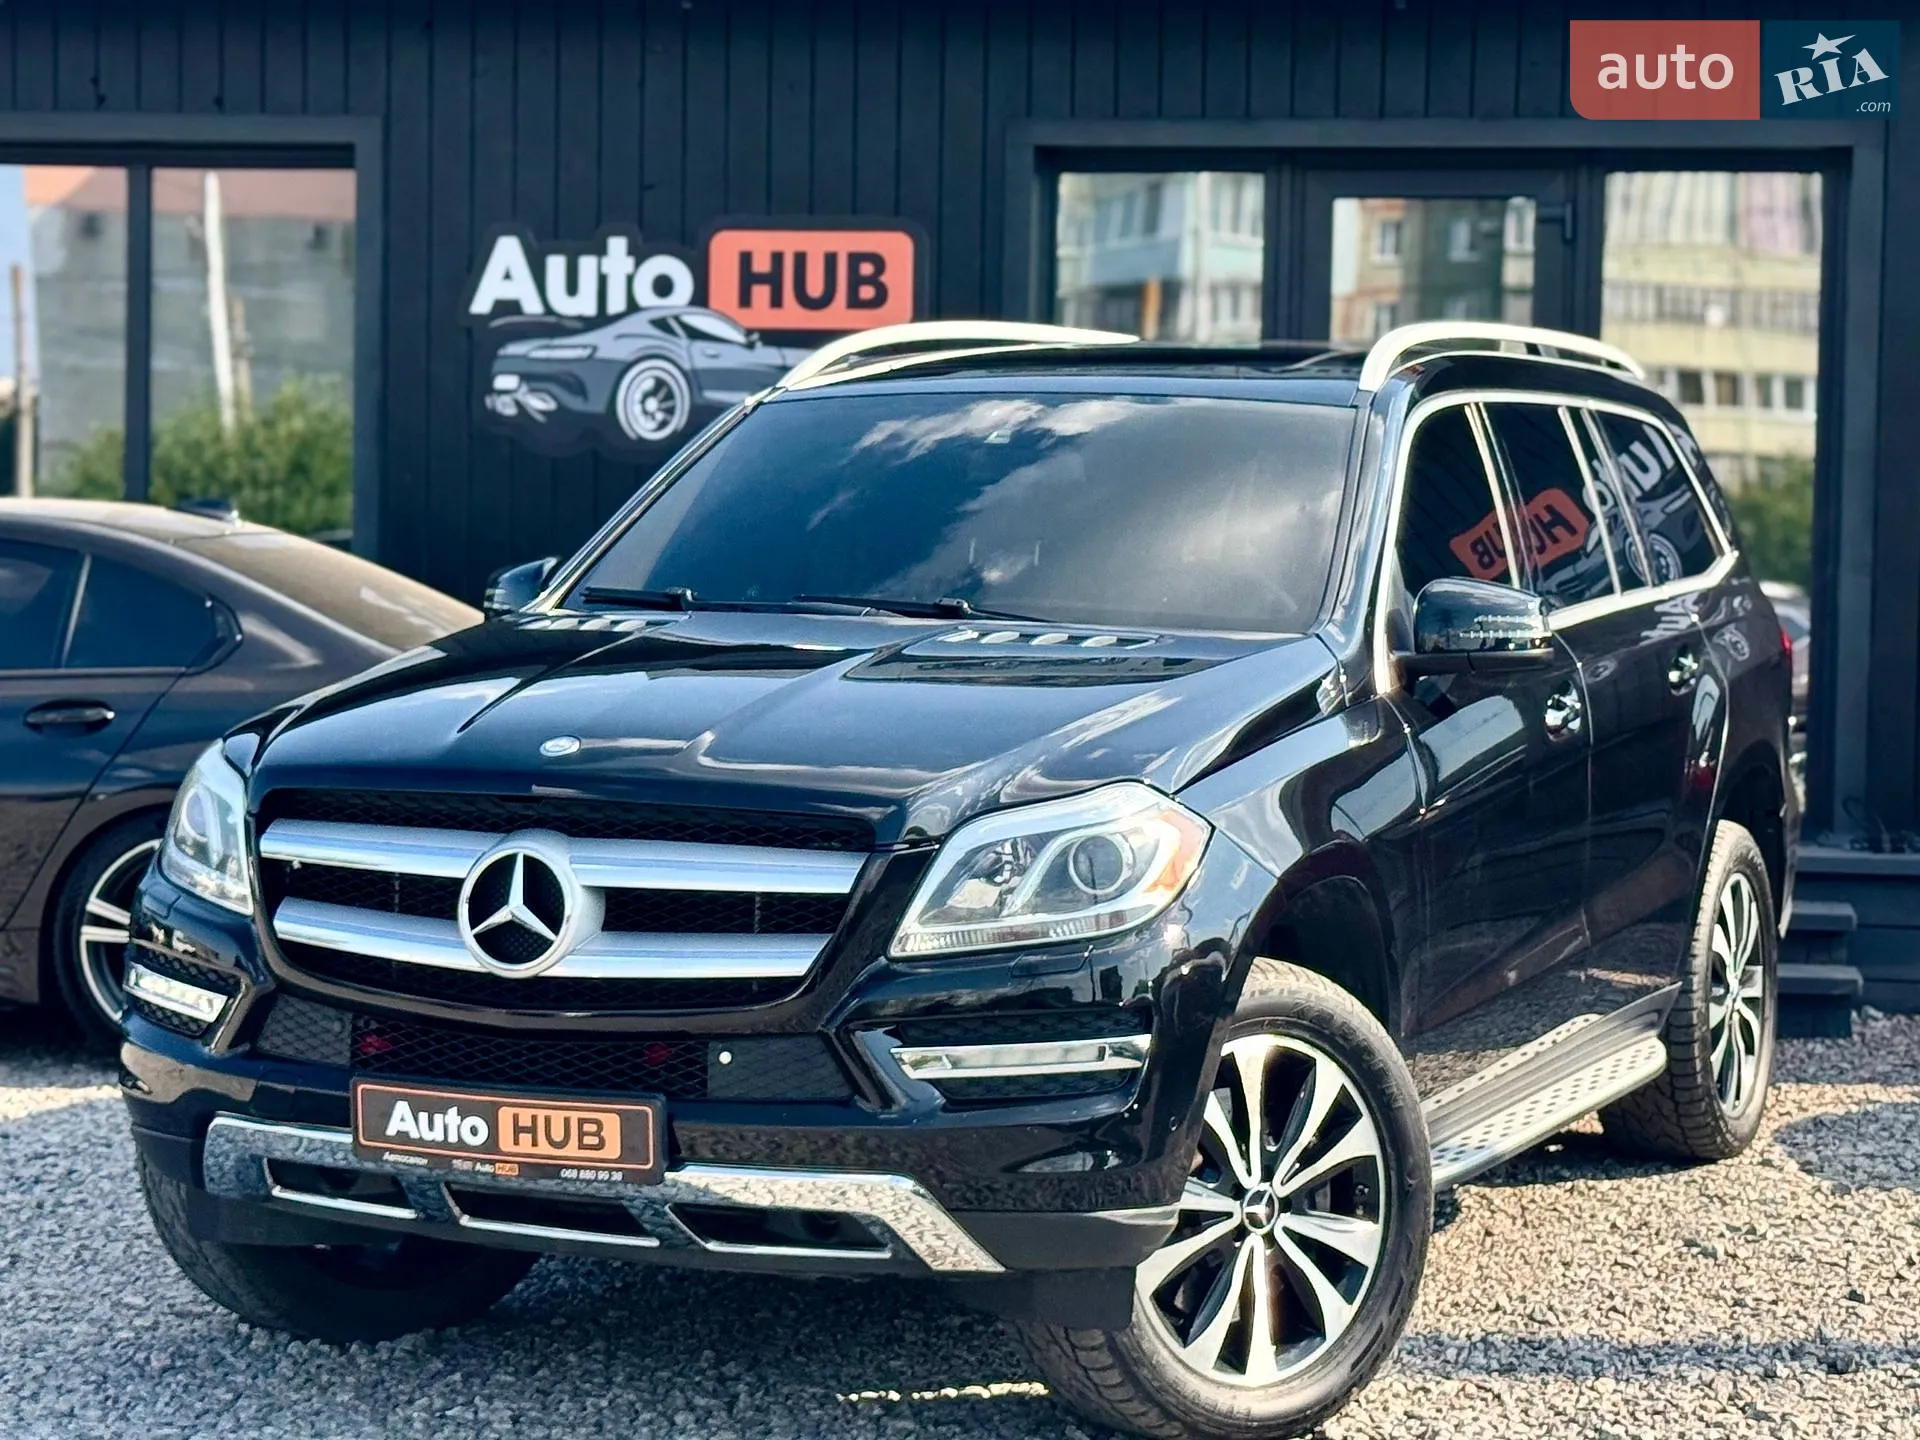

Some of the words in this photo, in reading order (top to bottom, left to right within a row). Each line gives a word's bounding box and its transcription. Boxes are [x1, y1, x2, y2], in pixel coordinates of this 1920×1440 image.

[469, 234, 695, 318] Auto
[738, 250, 888, 311] HUB
[385, 1100, 489, 1147] Auto
[512, 1112, 607, 1151] HUB
[474, 1162, 495, 1173] Auto
[497, 1164, 517, 1174] HUB
